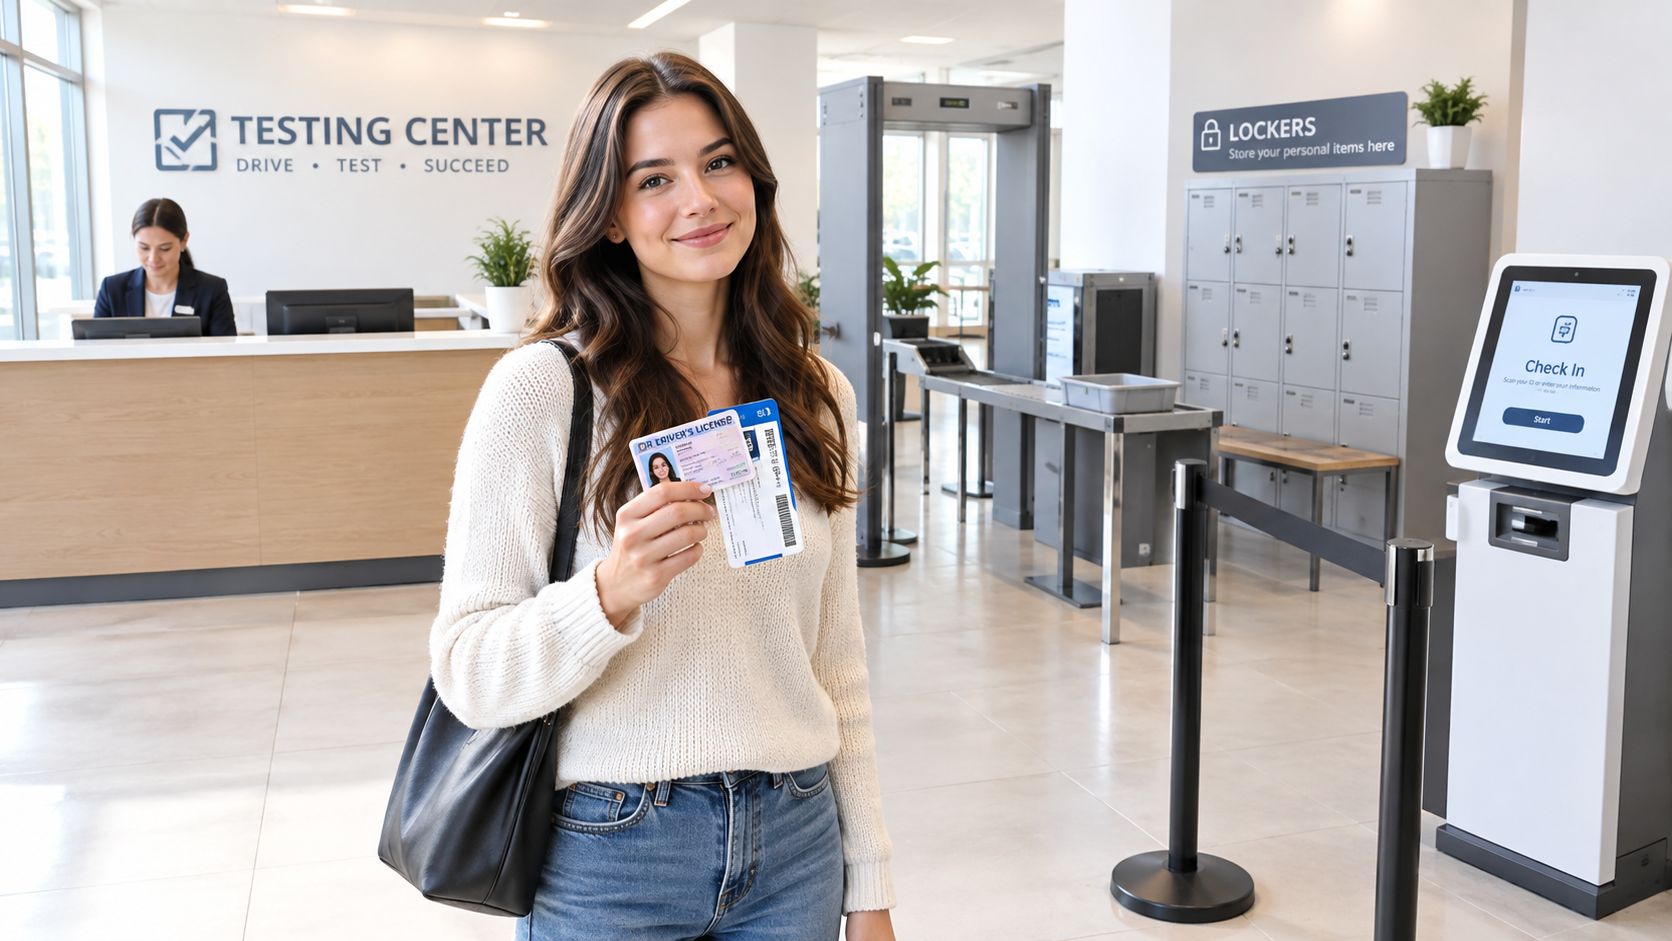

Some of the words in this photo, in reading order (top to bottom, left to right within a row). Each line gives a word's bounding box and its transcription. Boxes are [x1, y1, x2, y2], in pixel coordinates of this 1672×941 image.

[231, 116, 391, 145] TESTING
[405, 117, 548, 146] CENTER
[1229, 117, 1316, 141] LOCKERS
[1229, 148, 1255, 159] Store
[1257, 149, 1281, 160] your
[1283, 143, 1330, 159] personal
[1333, 142, 1364, 154] items
[1368, 140, 1395, 152] here
[236, 158, 294, 172] DRIVE
[336, 158, 382, 172] TEST
[424, 159, 509, 172] SUCCEED
[1525, 359, 1568, 376] Check
[1571, 363, 1585, 377] In
[1533, 415, 1552, 424] Start
